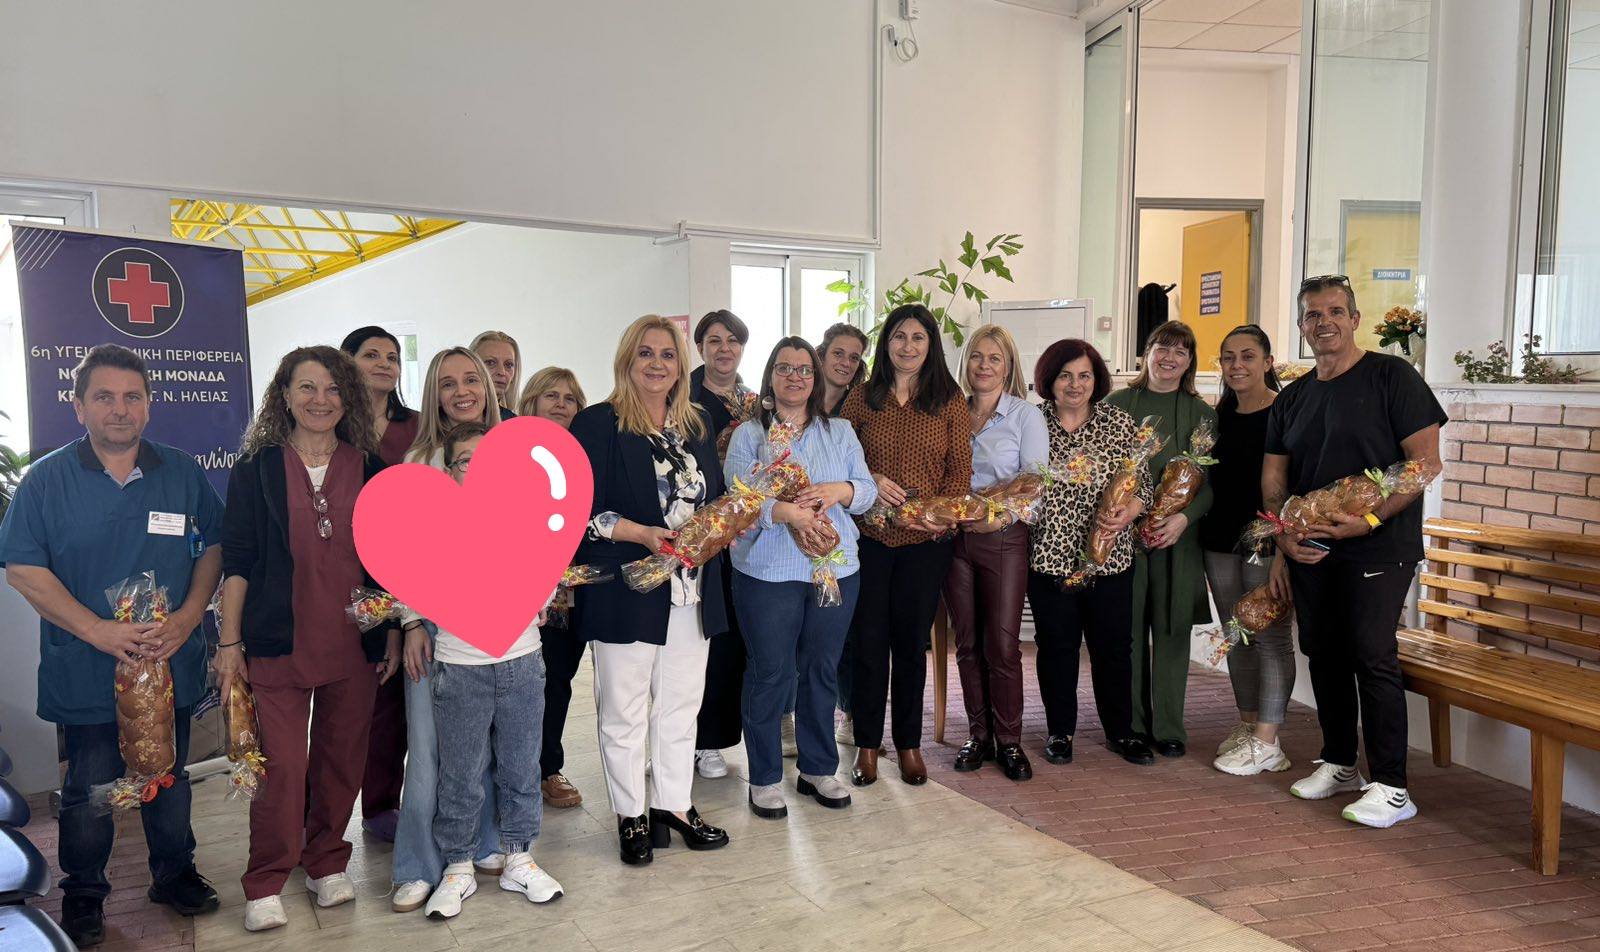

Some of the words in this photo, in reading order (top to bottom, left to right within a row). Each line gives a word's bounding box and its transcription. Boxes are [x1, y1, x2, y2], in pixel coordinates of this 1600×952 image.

[31, 345, 50, 360] 6η
[55, 346, 161, 359] ΥΓΕΙΙΚΗ
[166, 349, 244, 362] ΠΕΡΙΦΕΡΕΙΑ
[165, 370, 225, 382] ΜΟΝΑΔΑ
[163, 391, 177, 402] Ν.
[181, 391, 229, 402] ΗΛΕΙΑΣ
